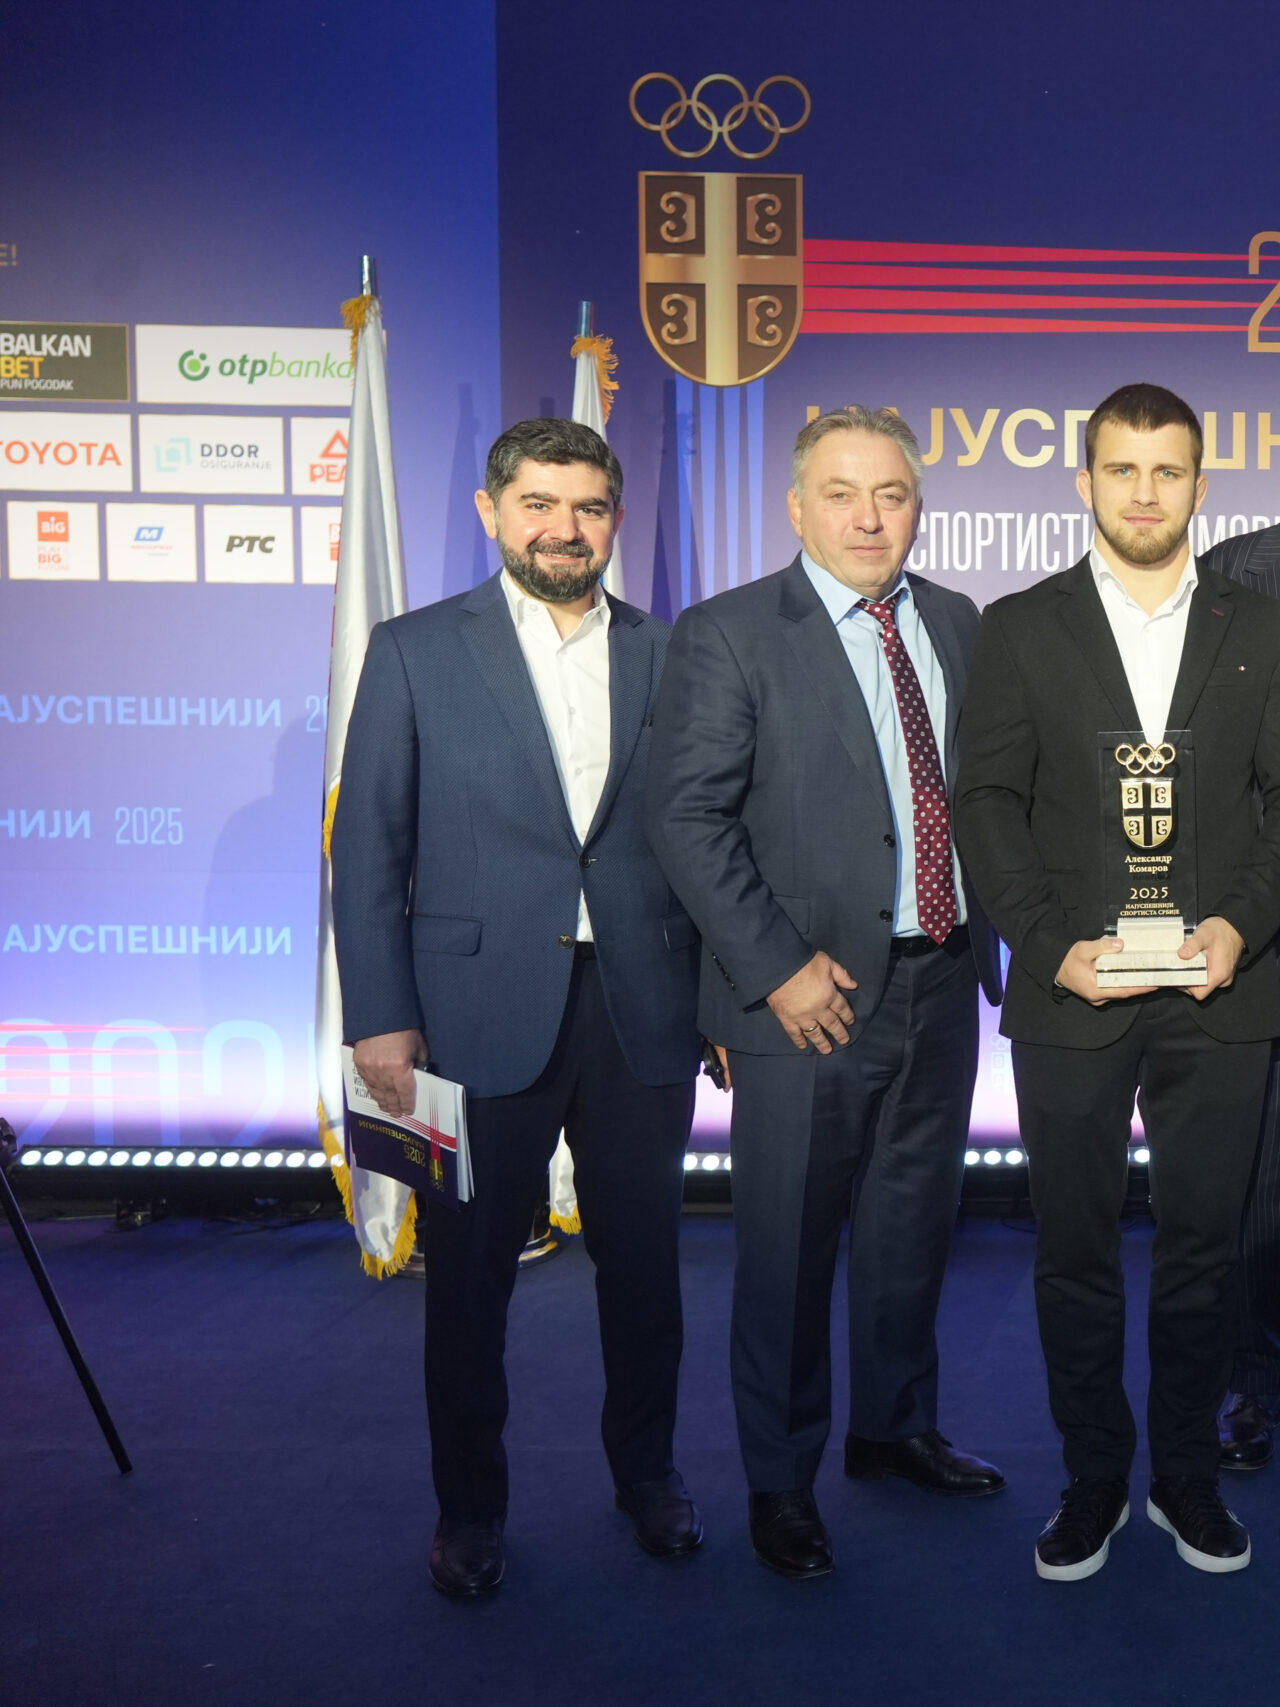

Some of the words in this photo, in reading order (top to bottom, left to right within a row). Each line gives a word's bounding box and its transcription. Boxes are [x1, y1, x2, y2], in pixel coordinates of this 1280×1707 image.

[0, 333, 92, 357] BALKAN
[0, 356, 44, 379] BET
[218, 352, 352, 384] otpbanka
[1, 379, 22, 389] PUN
[24, 379, 73, 391] POGODAK
[0, 440, 122, 467] OYOTA
[200, 443, 259, 458] DDOR
[200, 459, 272, 470] OSIGURANJE
[38, 554, 62, 564] BIG
[115, 807, 183, 845] 2025
[1124, 855, 1173, 864] Александр
[1129, 865, 1168, 874] Комаров
[1130, 887, 1168, 899] 2025
